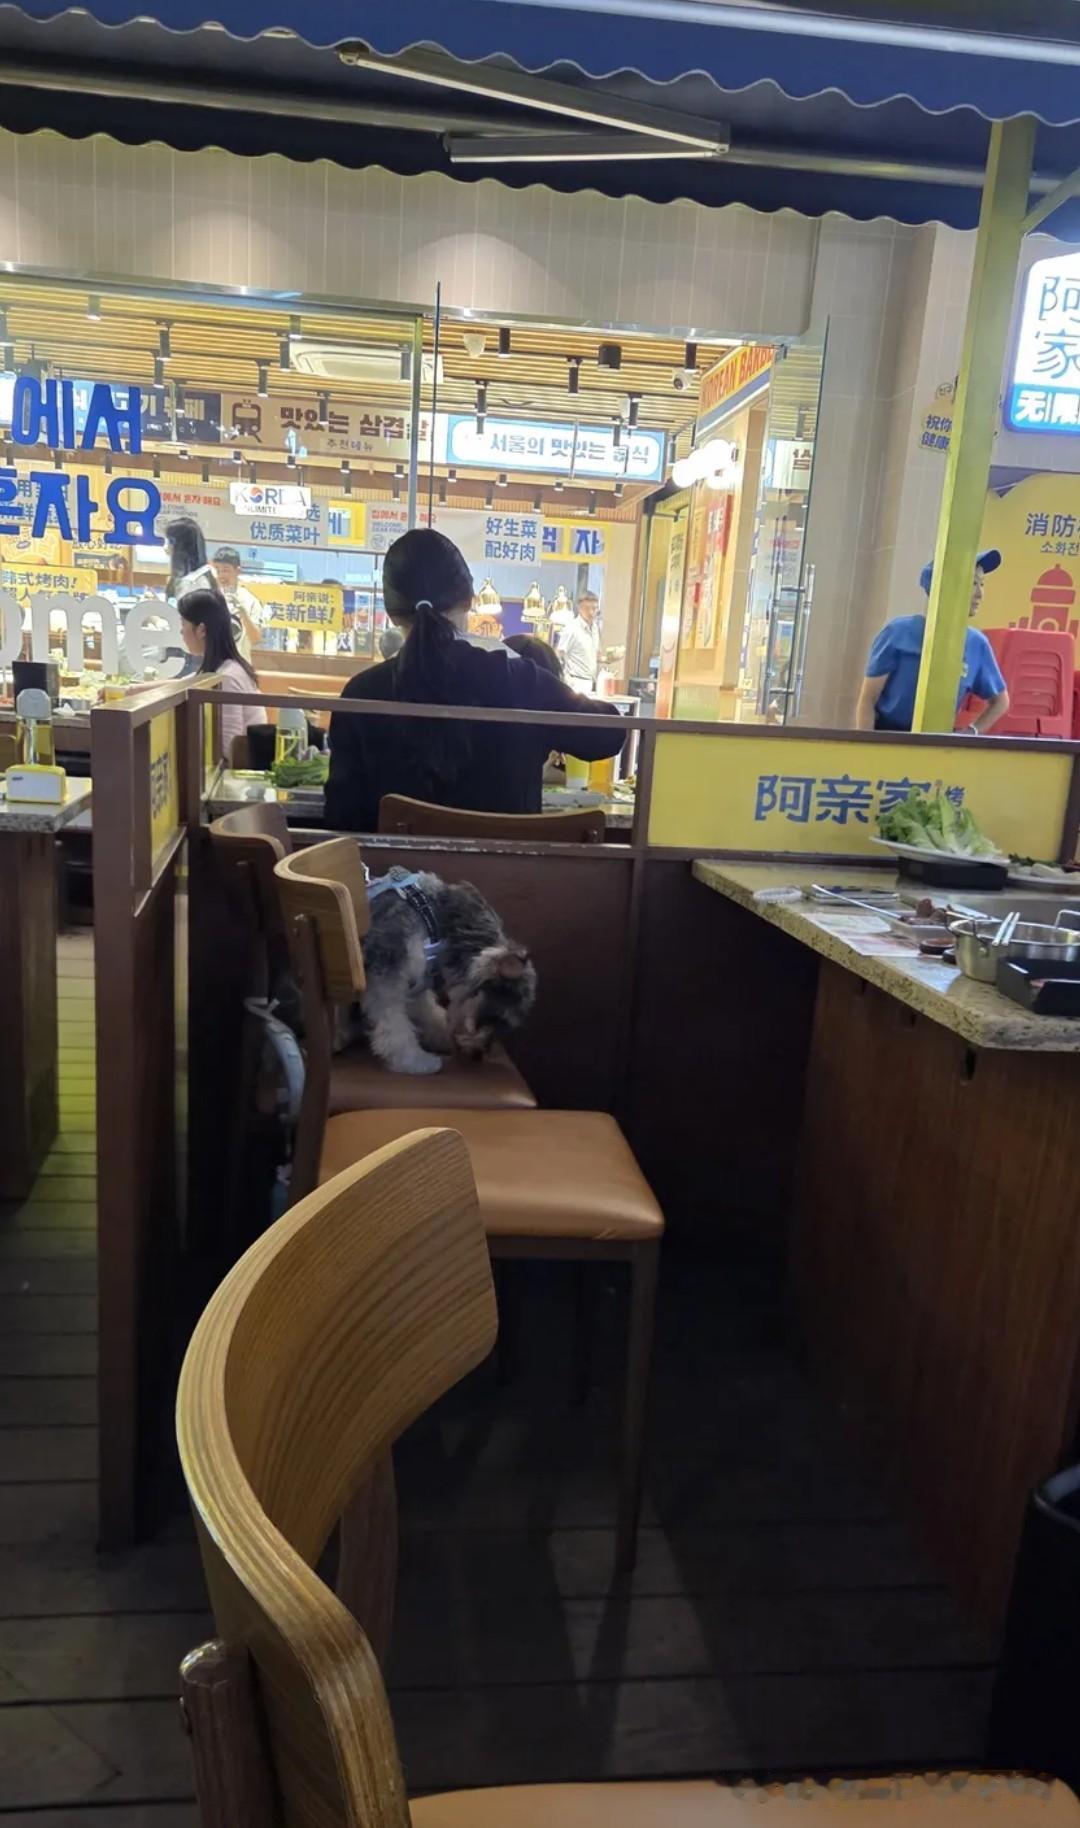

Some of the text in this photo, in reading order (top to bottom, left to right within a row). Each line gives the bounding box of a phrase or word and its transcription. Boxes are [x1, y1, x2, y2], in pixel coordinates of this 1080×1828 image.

[11, 376, 142, 454] 에서
[280, 406, 349, 435] 맛있는
[250, 521, 320, 545] 优质菜叶
[486, 517, 537, 538] 好生菜
[1025, 513, 1080, 538] 消防
[485, 540, 535, 561] 配好肉
